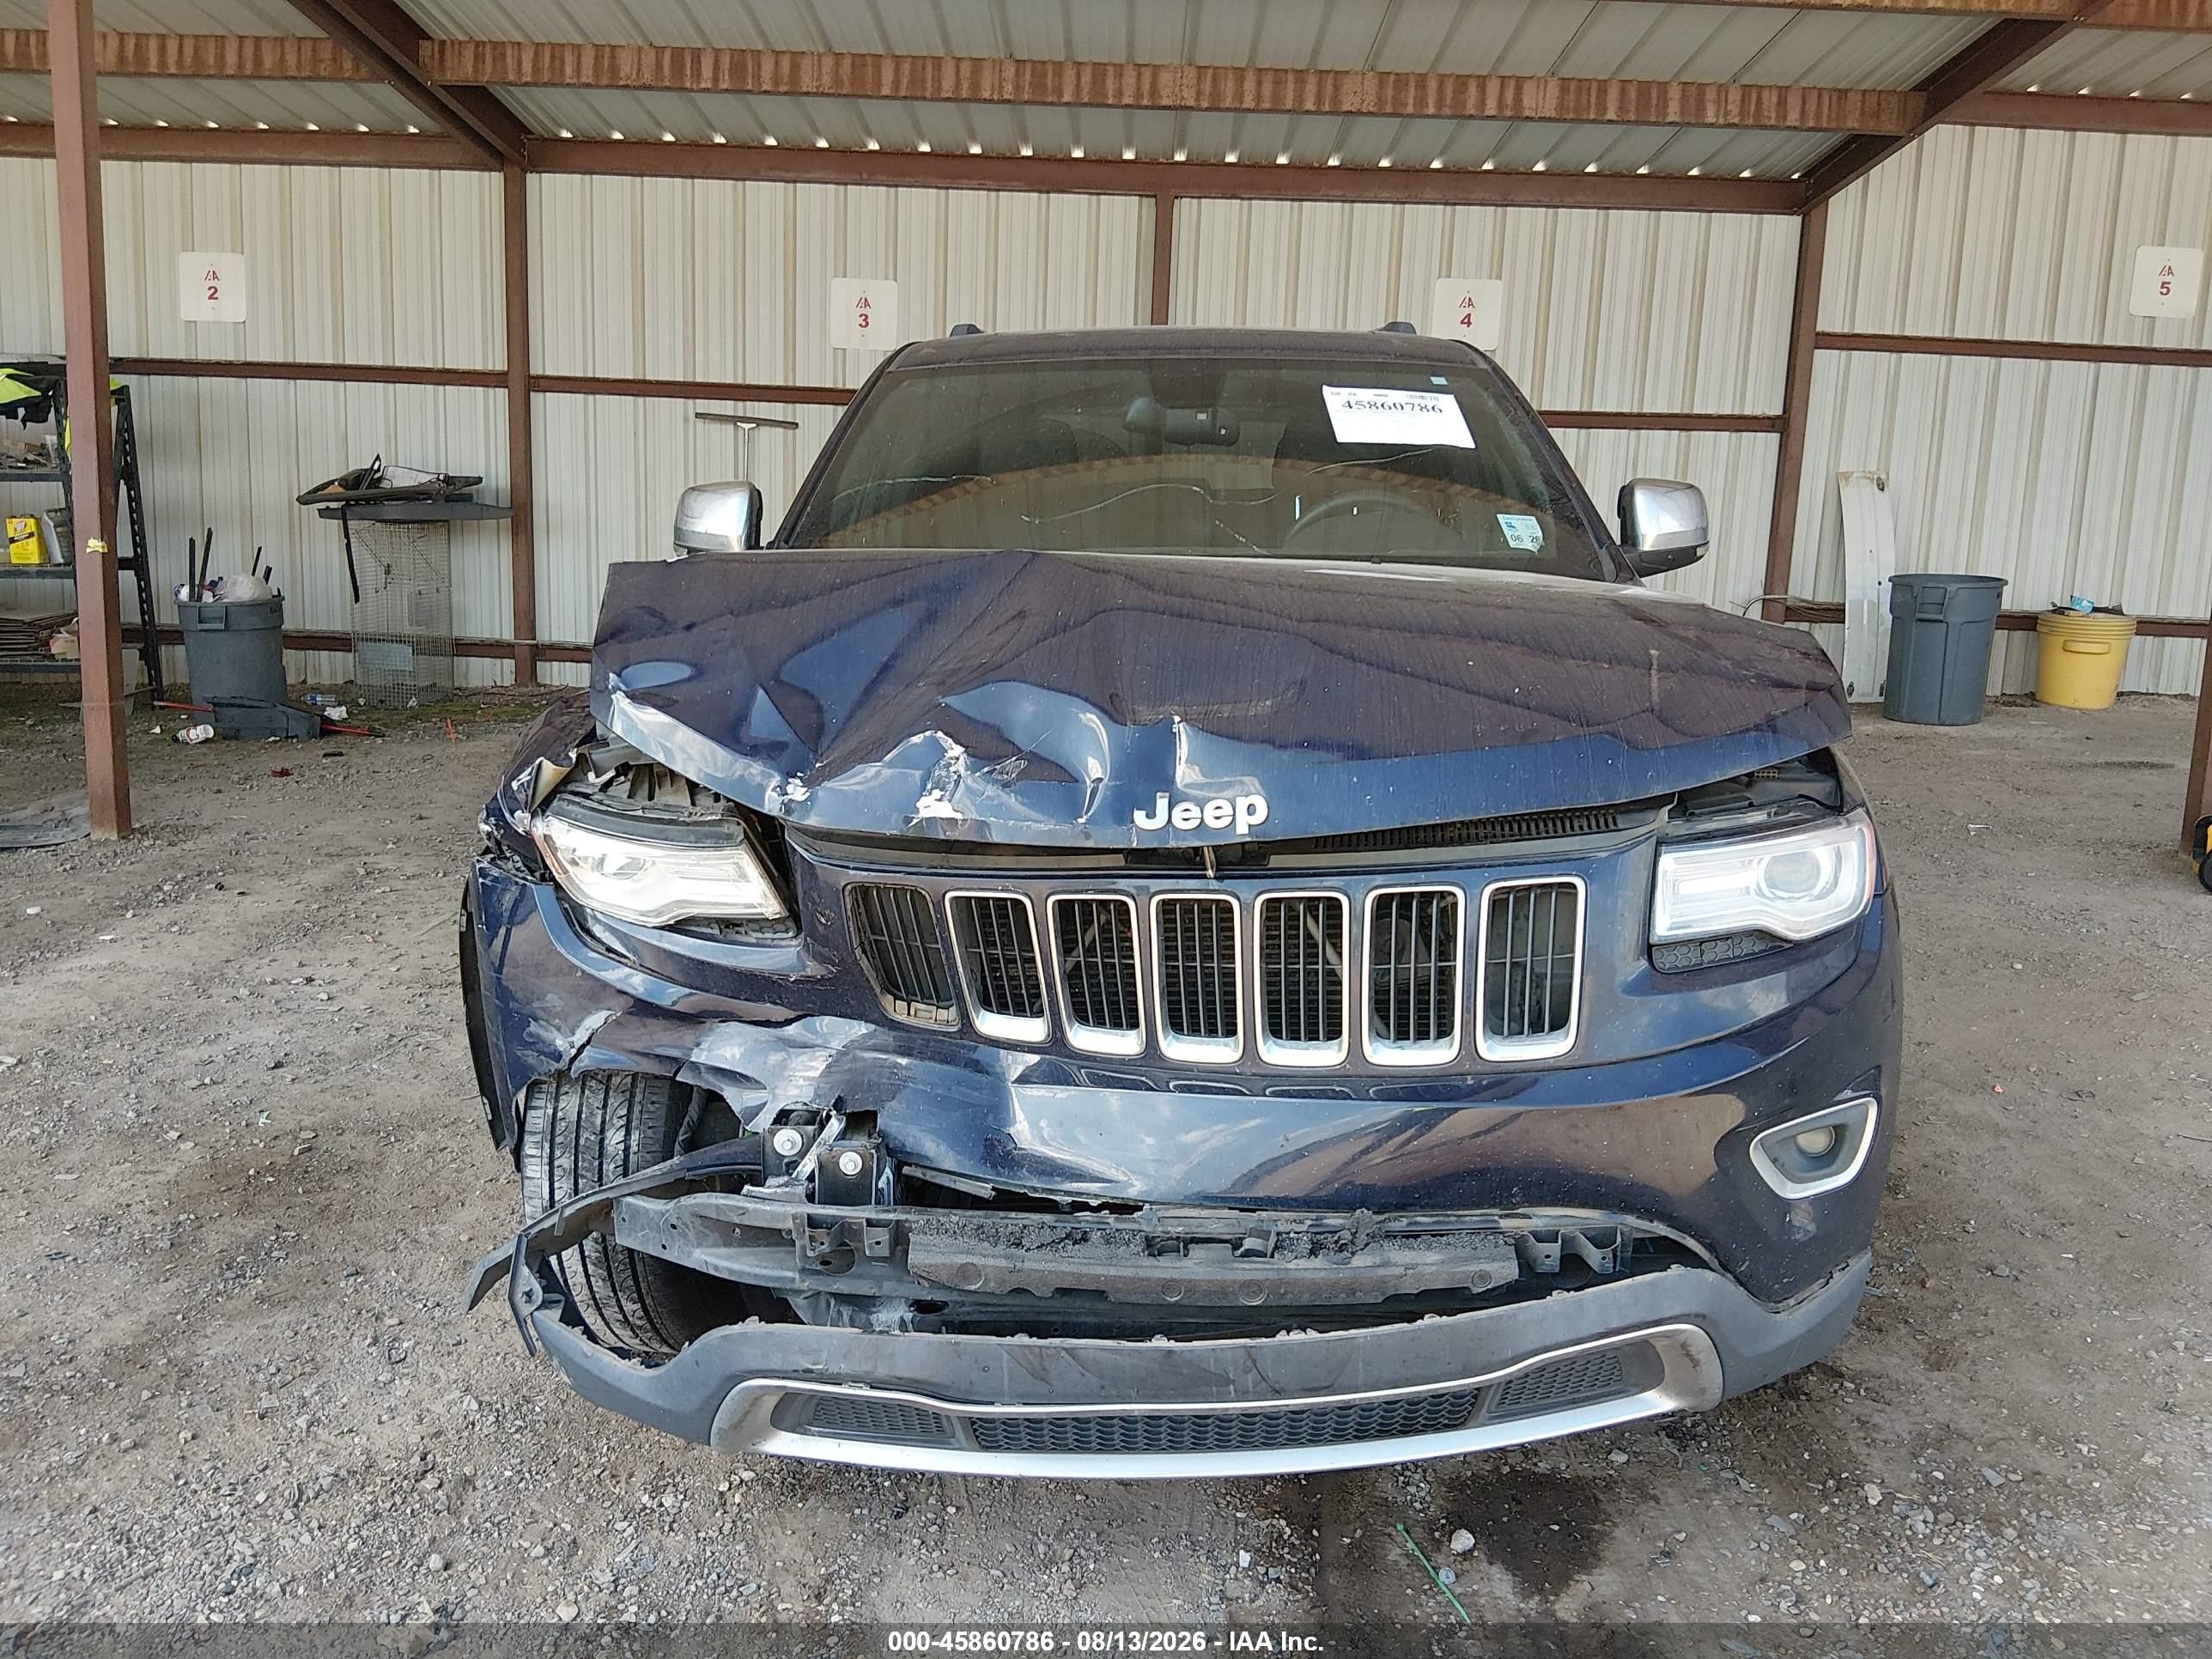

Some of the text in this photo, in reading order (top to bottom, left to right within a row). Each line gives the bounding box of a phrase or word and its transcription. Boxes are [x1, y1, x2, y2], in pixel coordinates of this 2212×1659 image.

[207, 286, 219, 301] 2
[2159, 281, 2172, 296] 5
[858, 313, 870, 328] 3
[1460, 313, 1473, 328] 4
[1341, 400, 1443, 414] 45860786
[1133, 791, 1269, 836] Jeep
